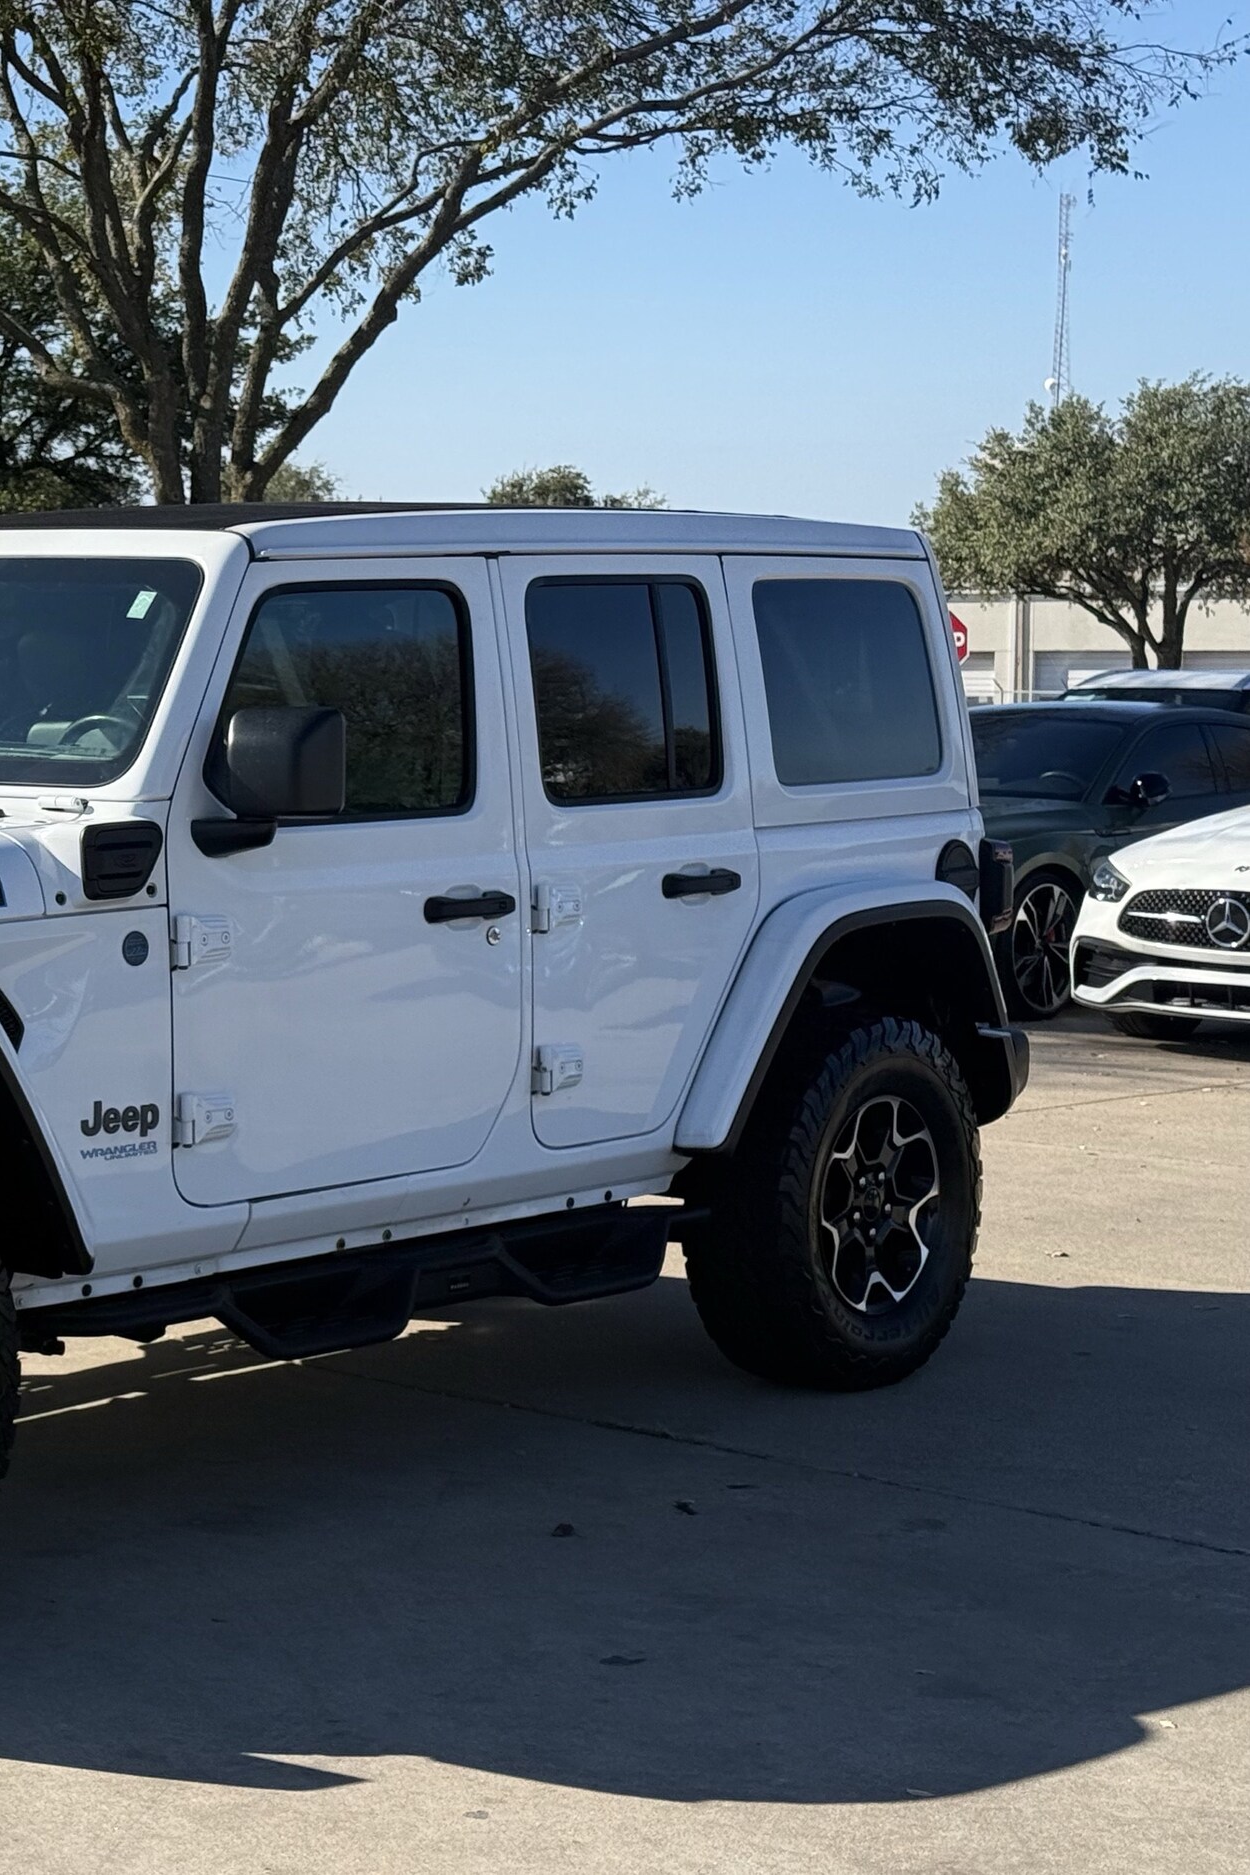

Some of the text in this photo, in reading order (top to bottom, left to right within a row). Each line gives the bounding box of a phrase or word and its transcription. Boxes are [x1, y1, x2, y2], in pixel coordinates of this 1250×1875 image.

[81, 1101, 159, 1137] Jeep
[80, 1141, 156, 1159] WRANGLER
[104, 1149, 157, 1160] UNLIMITED
